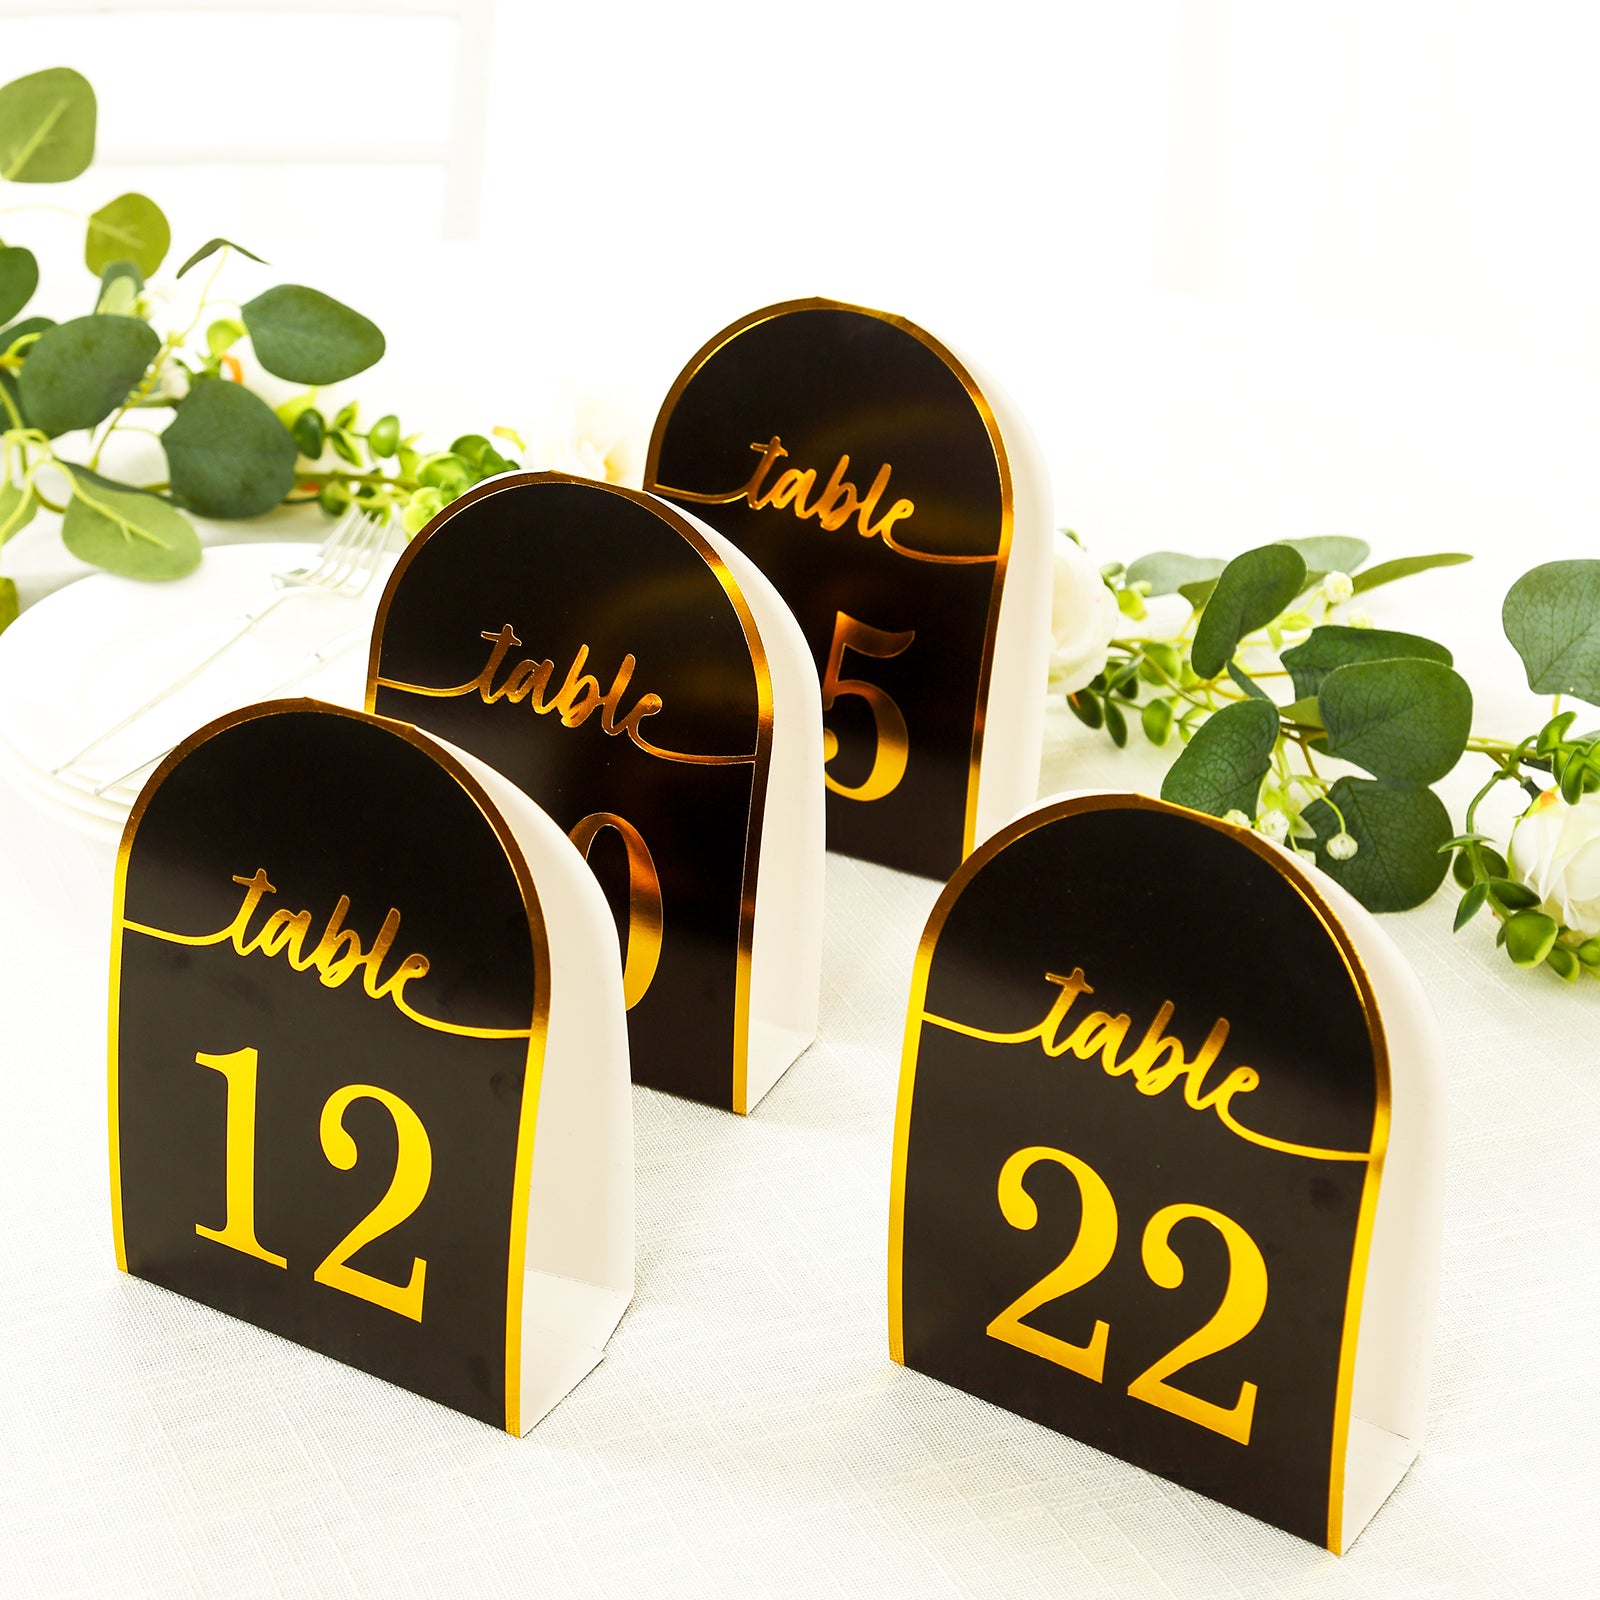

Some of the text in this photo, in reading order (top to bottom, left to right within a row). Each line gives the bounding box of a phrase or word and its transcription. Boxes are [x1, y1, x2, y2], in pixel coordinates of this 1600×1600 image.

[744, 436, 917, 545] table
[473, 624, 664, 745] table
[228, 867, 431, 1010] table
[1035, 966, 1262, 1116] table
[194, 1046, 433, 1324] 12
[985, 1145, 1269, 1447] 22
